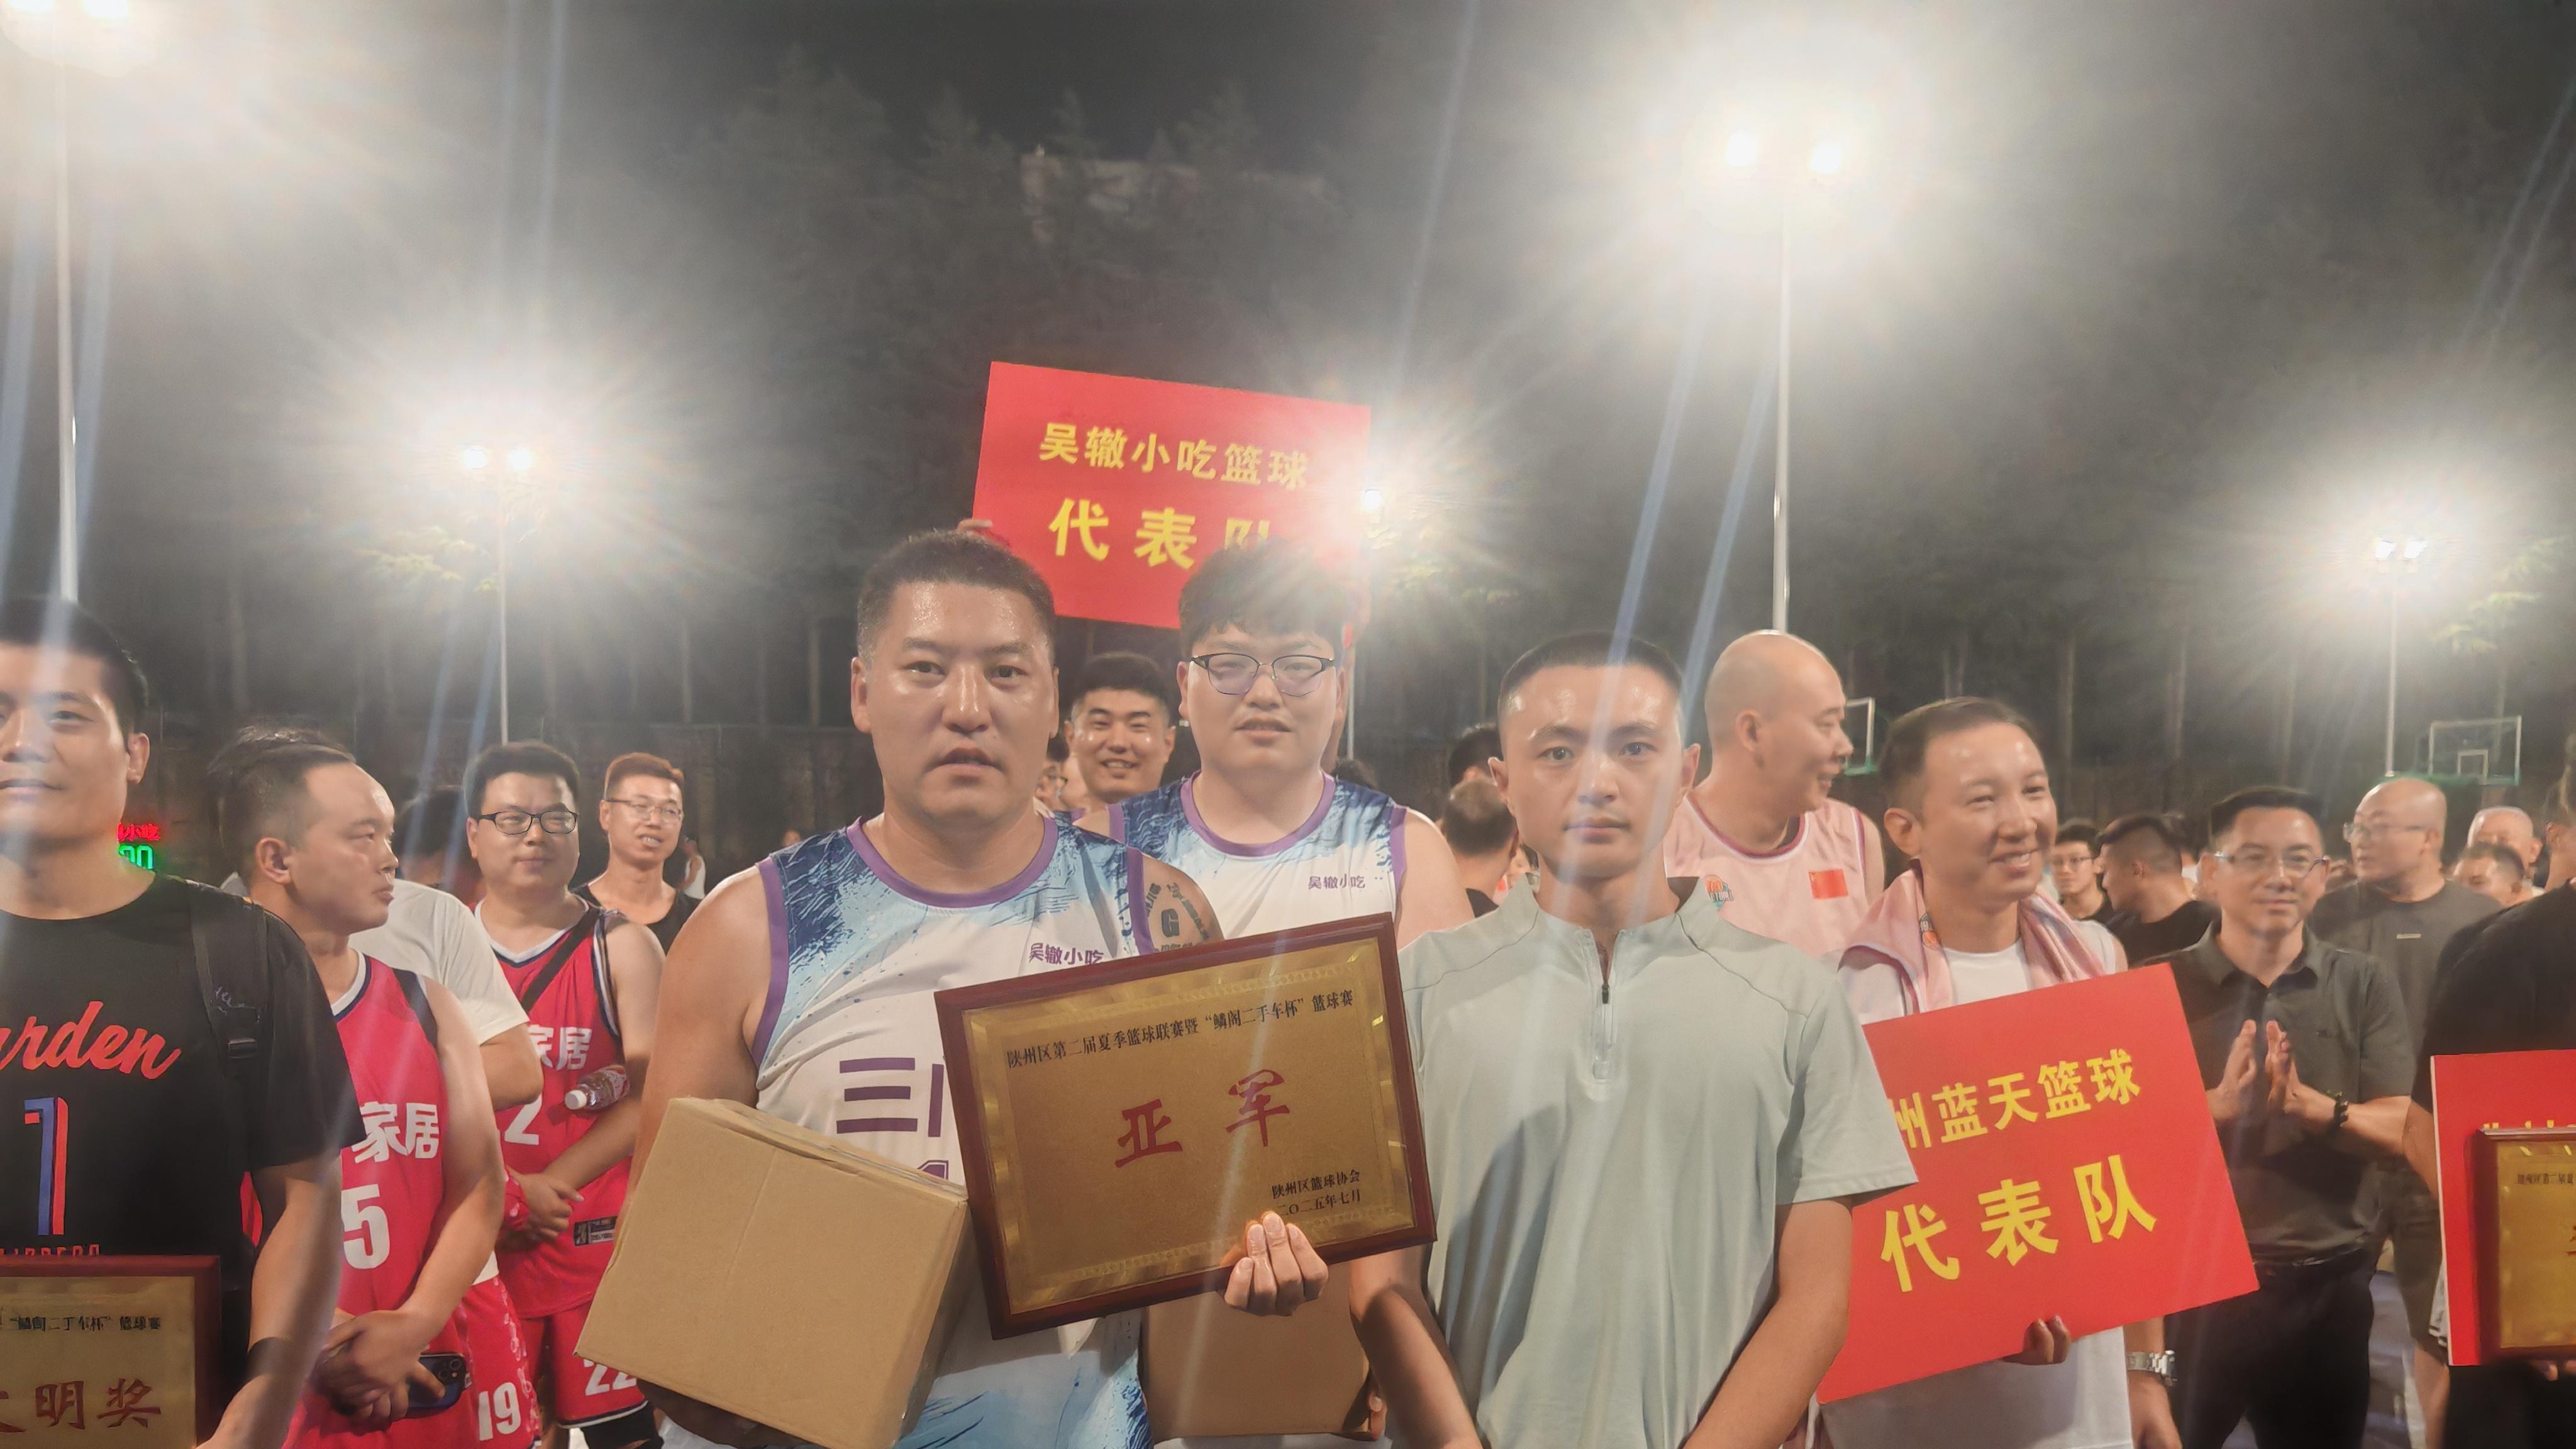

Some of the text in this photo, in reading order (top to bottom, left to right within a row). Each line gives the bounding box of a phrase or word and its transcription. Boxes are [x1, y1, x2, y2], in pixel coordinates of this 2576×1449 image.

[1039, 421, 1308, 490] 吴辙小吃篮球
[0, 1001, 182, 1079] rden
[1114, 1069, 1289, 1168] 亚军
[1887, 1048, 2140, 1148] 州蓝天篮球
[1880, 1155, 2156, 1292] 代表队
[478, 1382, 521, 1441] 19
